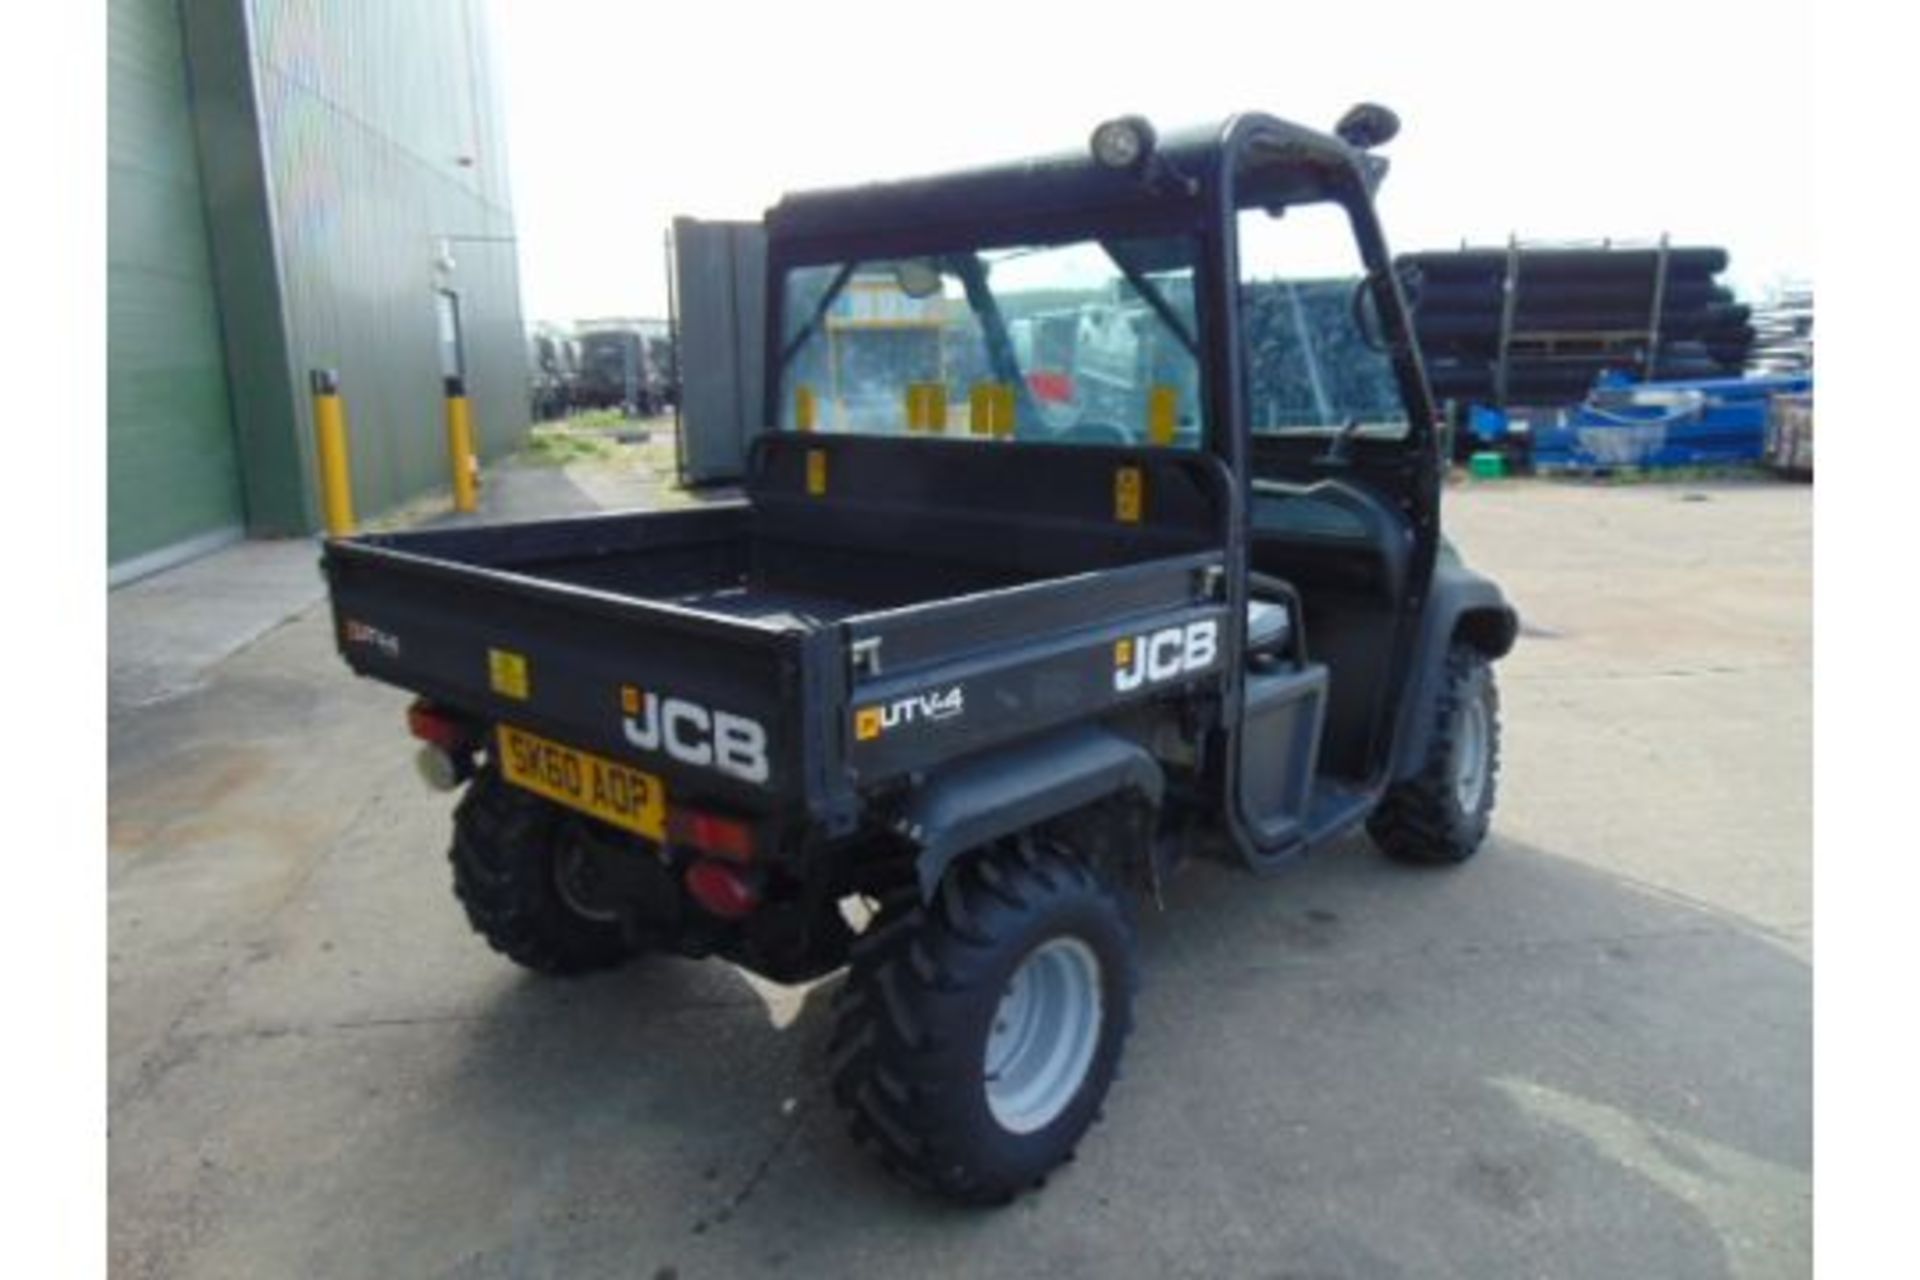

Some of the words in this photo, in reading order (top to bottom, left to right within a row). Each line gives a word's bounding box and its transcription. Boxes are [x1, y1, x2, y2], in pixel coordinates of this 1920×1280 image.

[1115, 620, 1217, 691] JCB
[509, 731, 583, 799] SK60
[623, 692, 769, 783] JCB
